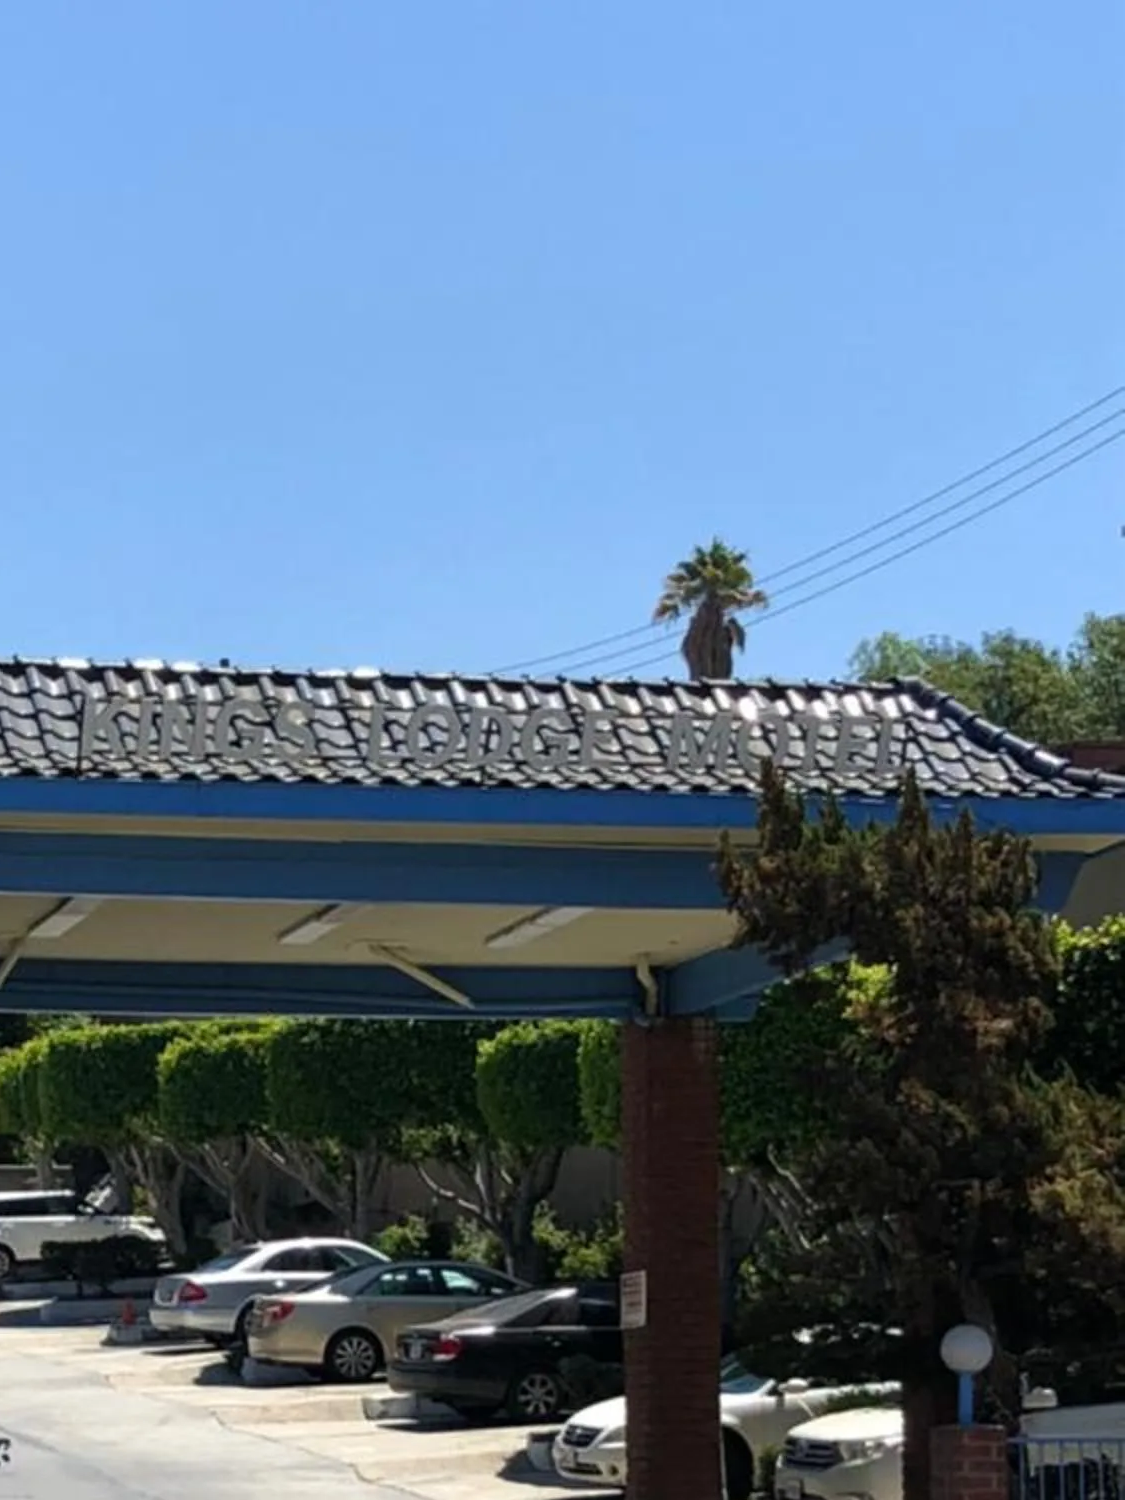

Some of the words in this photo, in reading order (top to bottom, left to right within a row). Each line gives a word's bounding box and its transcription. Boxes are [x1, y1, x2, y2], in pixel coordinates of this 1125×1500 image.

[80, 697, 317, 763] KINGS
[369, 703, 619, 769] LODGE
[665, 709, 908, 775] MOTEL
